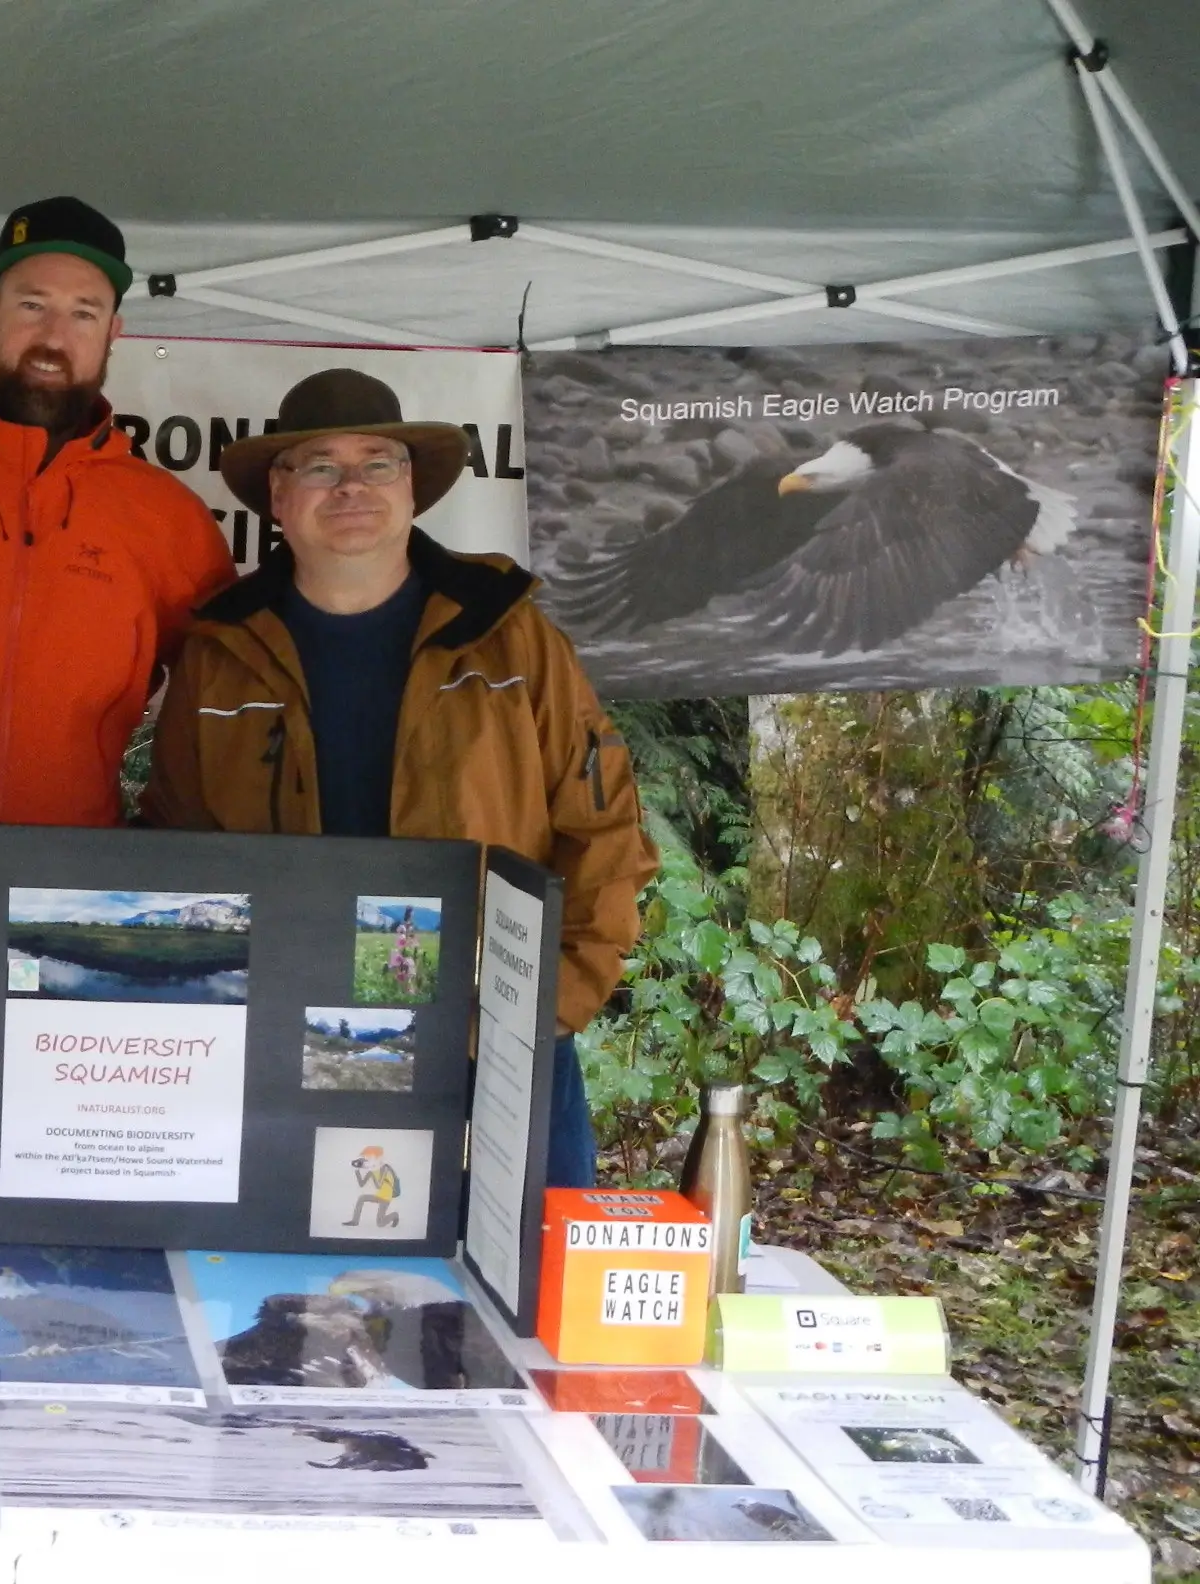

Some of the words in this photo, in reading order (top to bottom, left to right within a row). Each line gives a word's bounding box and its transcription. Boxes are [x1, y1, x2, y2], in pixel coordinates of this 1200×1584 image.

[620, 395, 752, 426] Squamish
[762, 393, 839, 421] Eagle
[849, 389, 933, 414] Watch
[943, 387, 1059, 414] Program
[495, 907, 528, 944] SQUAMISH
[494, 974, 520, 1006] SOCIETY
[35, 1033, 217, 1057] BIODIVERSITY
[54, 1063, 192, 1086] SQUAMISH
[46, 1127, 124, 1139] DOCUMENTING
[126, 1130, 196, 1141] BIODIVERSITY
[14, 1151, 43, 1160] within
[45, 1153, 60, 1161] the
[146, 1157, 174, 1165] Sound
[176, 1157, 223, 1166] Watershed
[74, 1142, 96, 1150] from
[126, 1144, 136, 1152] to
[138, 1144, 165, 1153] alpine
[60, 1166, 92, 1175] project
[94, 1167, 121, 1176] based
[122, 1168, 132, 1176] in
[133, 1168, 177, 1178] Squamish
[588, 1194, 659, 1204] THANK
[604, 1206, 649, 1215] YOU
[570, 1224, 708, 1248] DONATIONS
[607, 1272, 680, 1295] EAGLE
[605, 1299, 679, 1321] WATCH
[820, 1312, 872, 1327] Square
